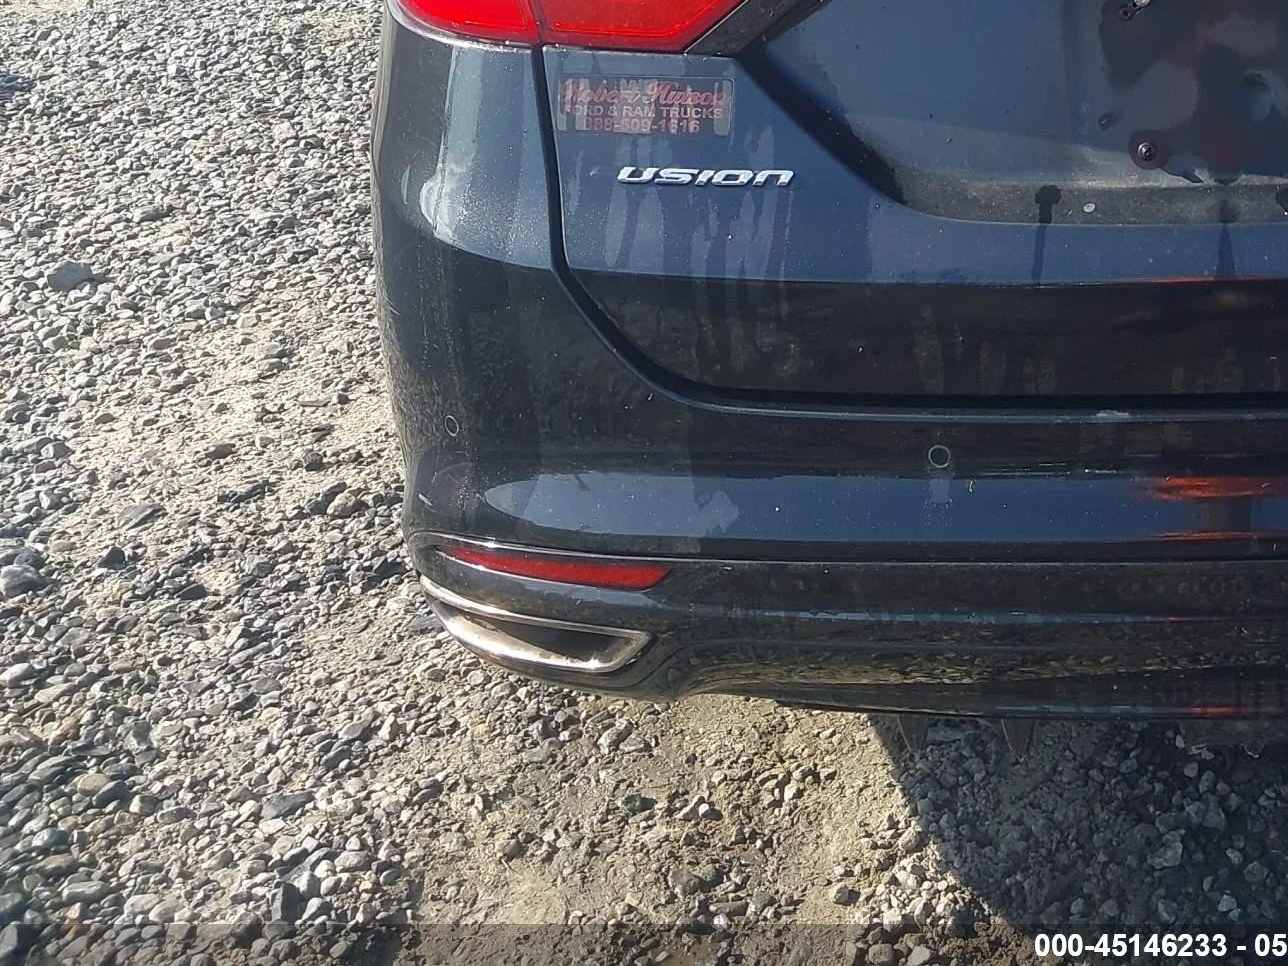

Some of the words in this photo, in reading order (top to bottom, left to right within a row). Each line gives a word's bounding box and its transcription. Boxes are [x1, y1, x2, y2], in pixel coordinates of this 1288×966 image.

[564, 105, 604, 116] FORD
[608, 106, 618, 116] &
[622, 106, 656, 117] RAM
[660, 107, 723, 119] TRUCKS
